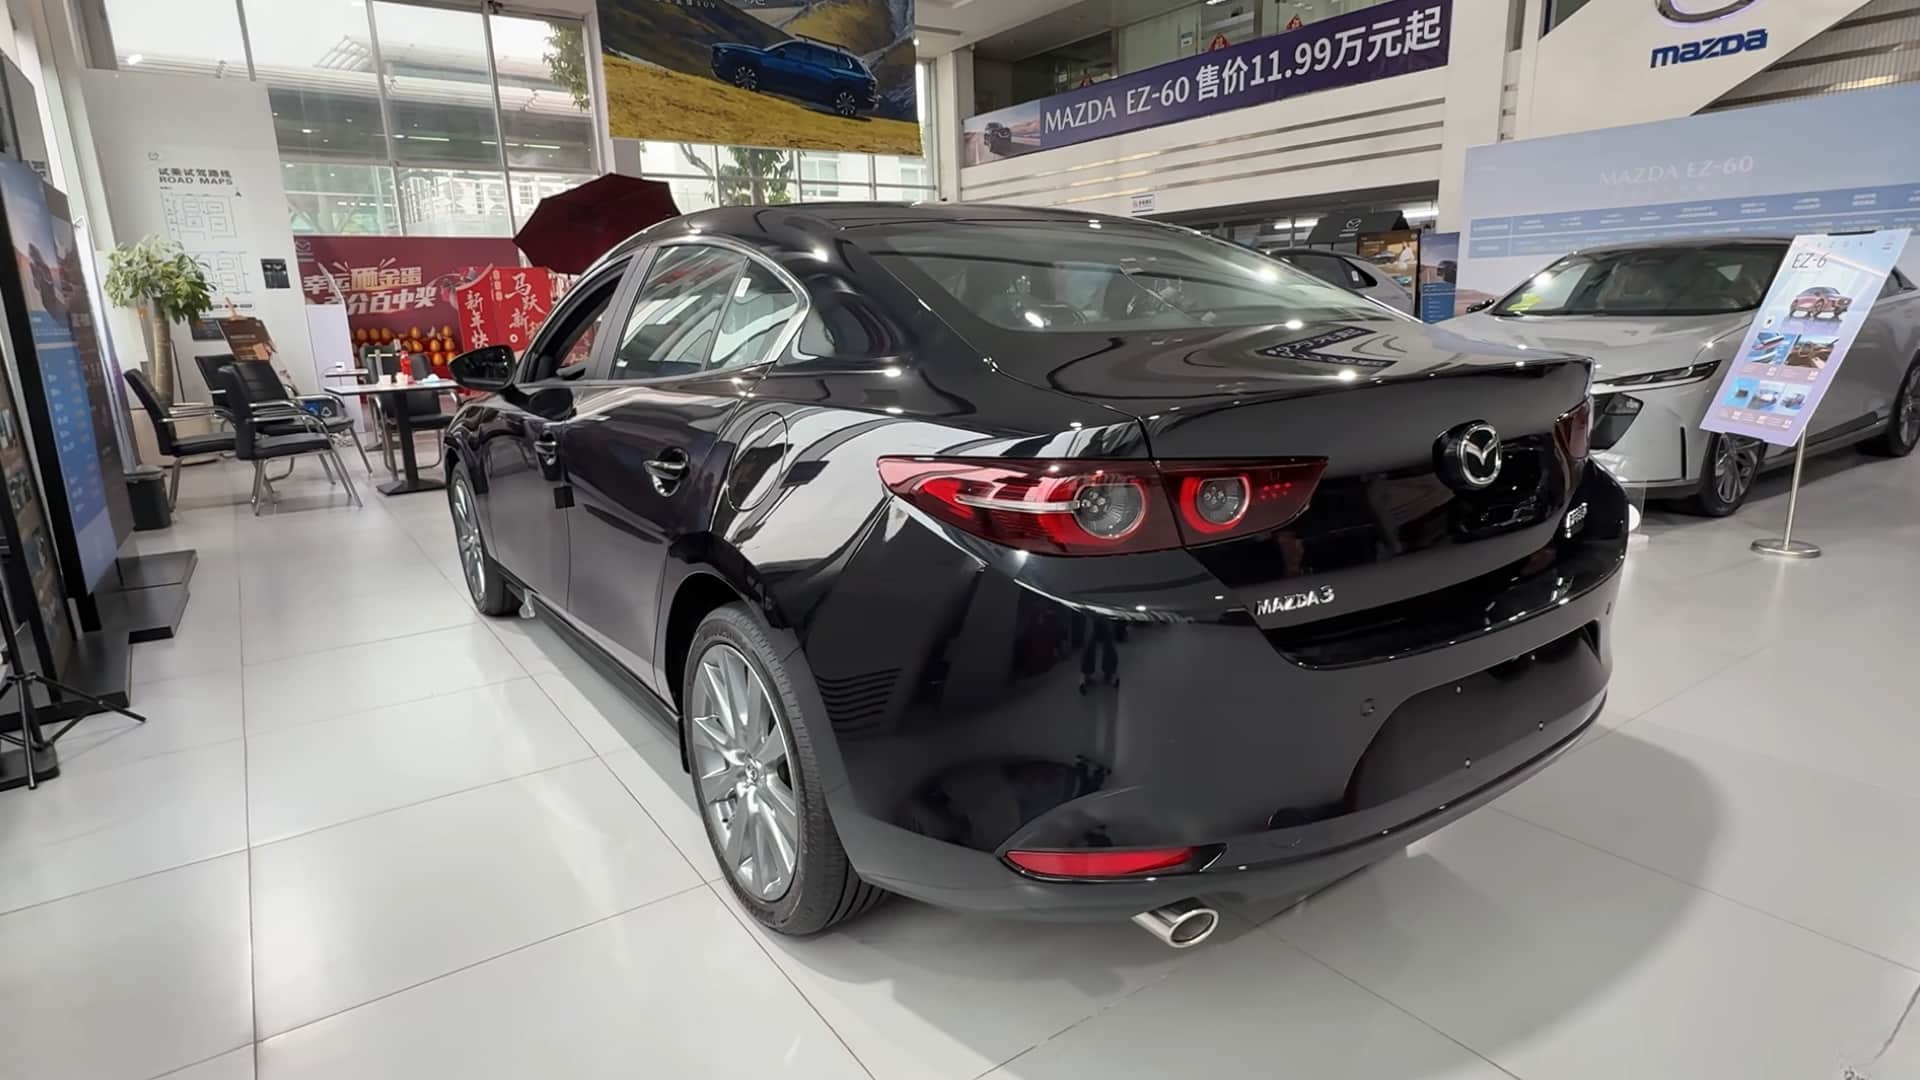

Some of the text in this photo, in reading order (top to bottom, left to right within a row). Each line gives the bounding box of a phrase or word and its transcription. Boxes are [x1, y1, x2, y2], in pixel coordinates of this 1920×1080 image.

[1044, 5, 1442, 134] MAZDA EZ-60 售价11.99万元起
[159, 176, 233, 186] ROAD MAPS
[1600, 155, 1754, 185] MAZDA EZ-60
[1791, 252, 1830, 269] EZ-6
[323, 286, 438, 316] 分百中奖
